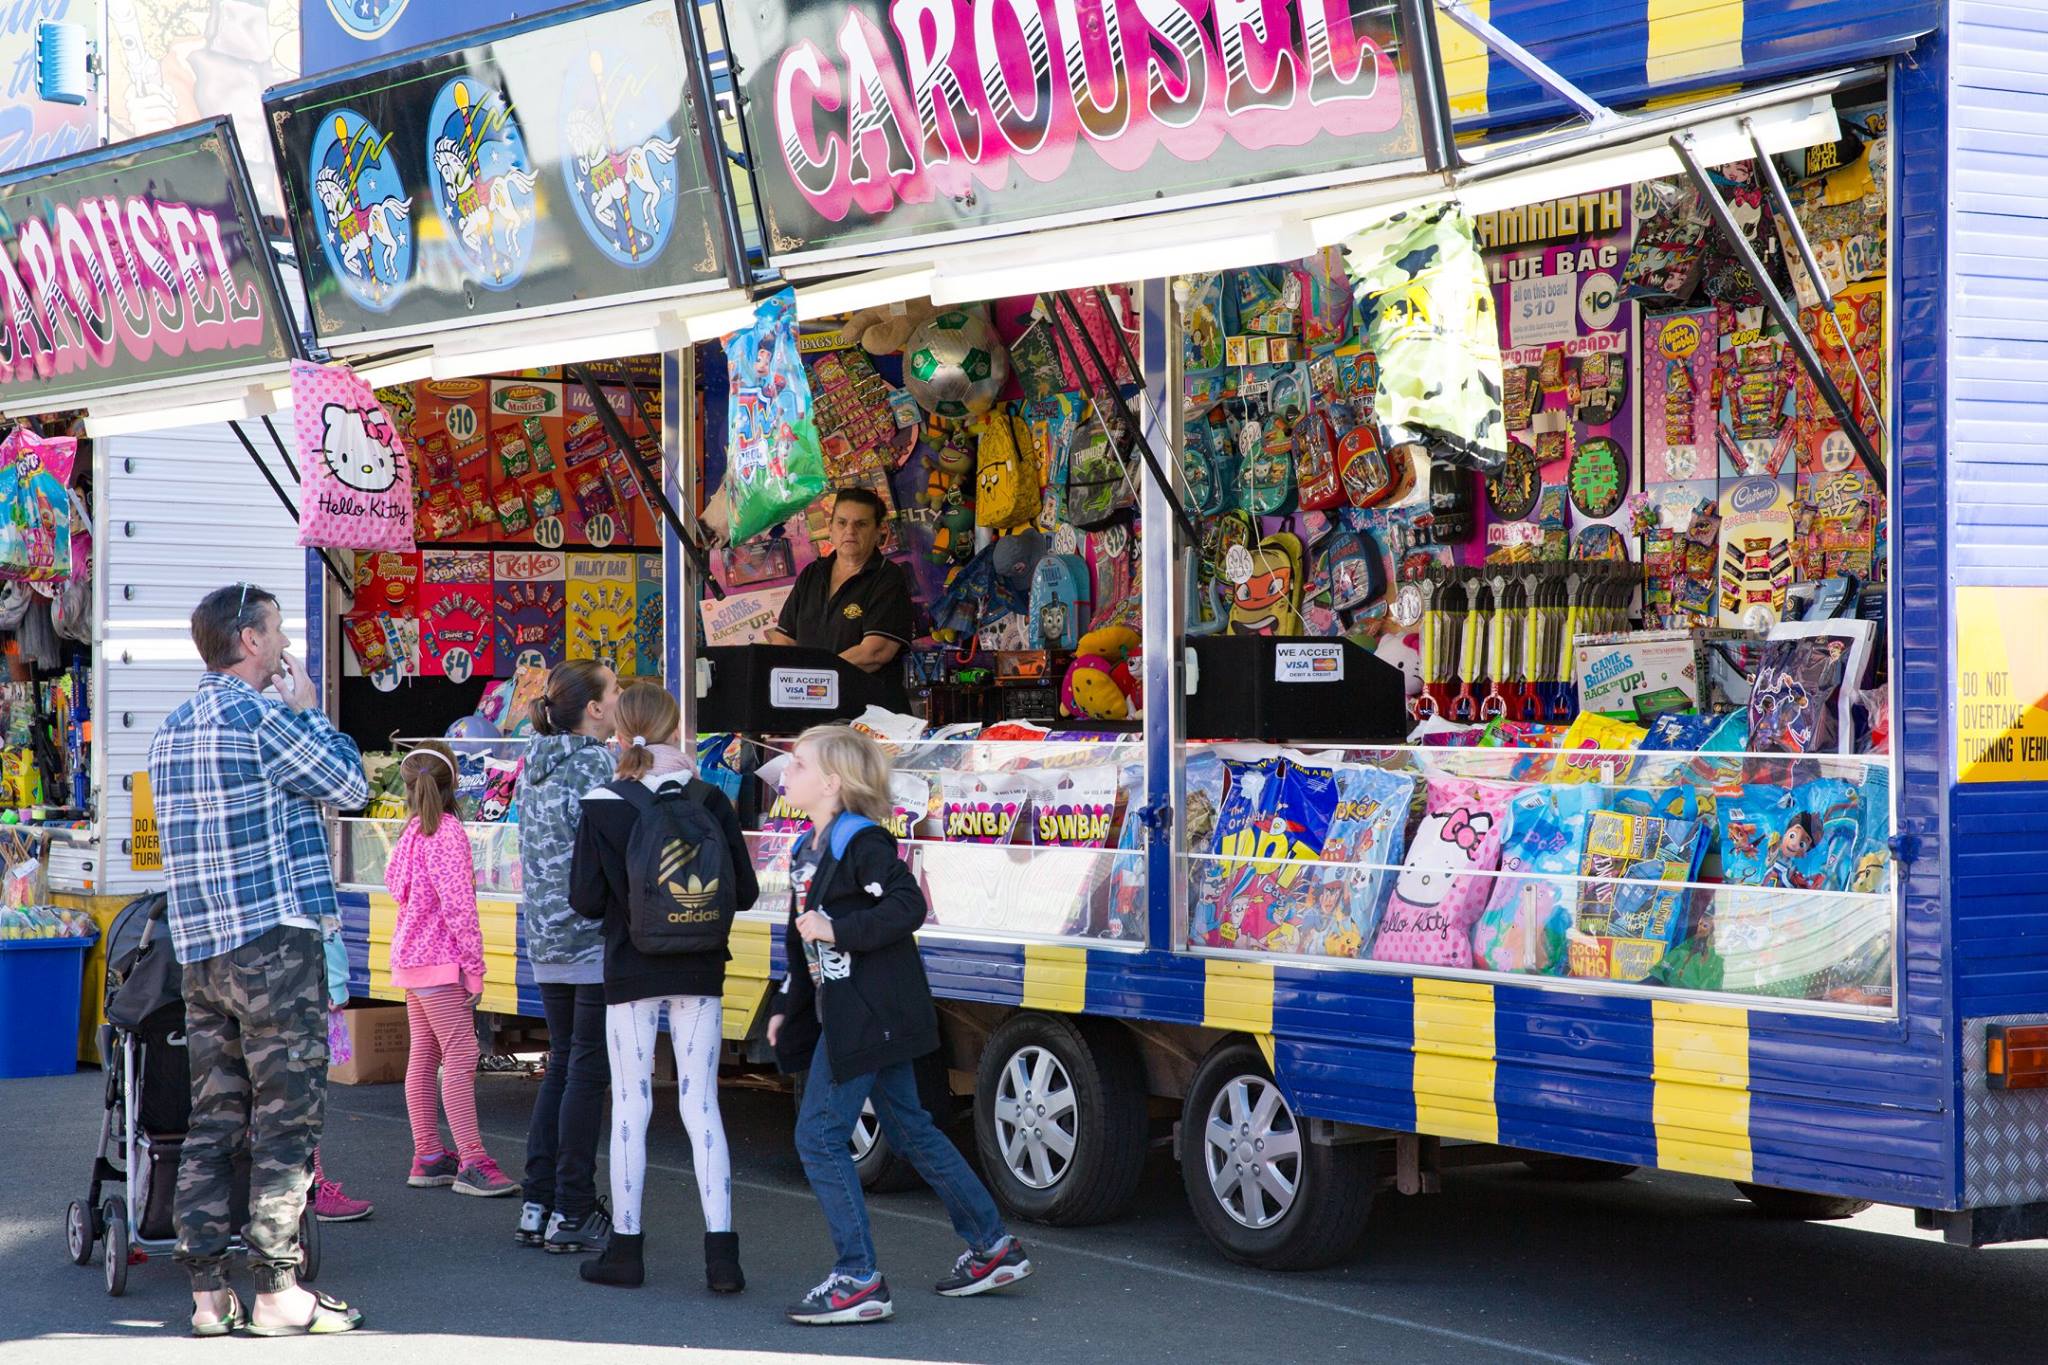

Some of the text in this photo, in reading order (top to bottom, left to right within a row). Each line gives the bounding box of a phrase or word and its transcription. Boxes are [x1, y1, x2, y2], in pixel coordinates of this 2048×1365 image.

[774, 0, 1382, 196] CAROUSEL
[1476, 190, 1622, 248] AMMOTH
[1493, 245, 1618, 284] LUE BAG
[1548, 280, 1568, 298] board
[1522, 300, 1556, 319] $10
[1567, 334, 1621, 355] CANDY
[573, 392, 626, 409] WOKA
[448, 408, 474, 436] $10
[318, 493, 409, 526] Hello Kitty
[536, 518, 561, 545] $10
[588, 515, 612, 542] $10
[574, 560, 628, 577] MILKY BAR
[718, 598, 749, 620] GAME
[712, 623, 739, 642] RACK
[1278, 648, 1341, 657] WE ACCEPT
[1590, 651, 1622, 675] GAME
[445, 649, 470, 680] $4
[1286, 661, 1309, 669] VISA
[1583, 654, 1635, 689] BILLIARDS
[780, 676, 793, 684] WE
[1584, 682, 1610, 701] RACK
[1619, 671, 1648, 694] UP!
[1963, 671, 2009, 697] DO NOT
[1963, 704, 2024, 729] OVERTAKE
[1964, 736, 2048, 763] TURNING VEHI
[135, 818, 148, 832] DO
[135, 835, 160, 849] OVER
[134, 852, 162, 866] TURN
[667, 908, 720, 923] adidas
[1411, 911, 1451, 941] Kitty
[1571, 957, 1607, 978] WHO
